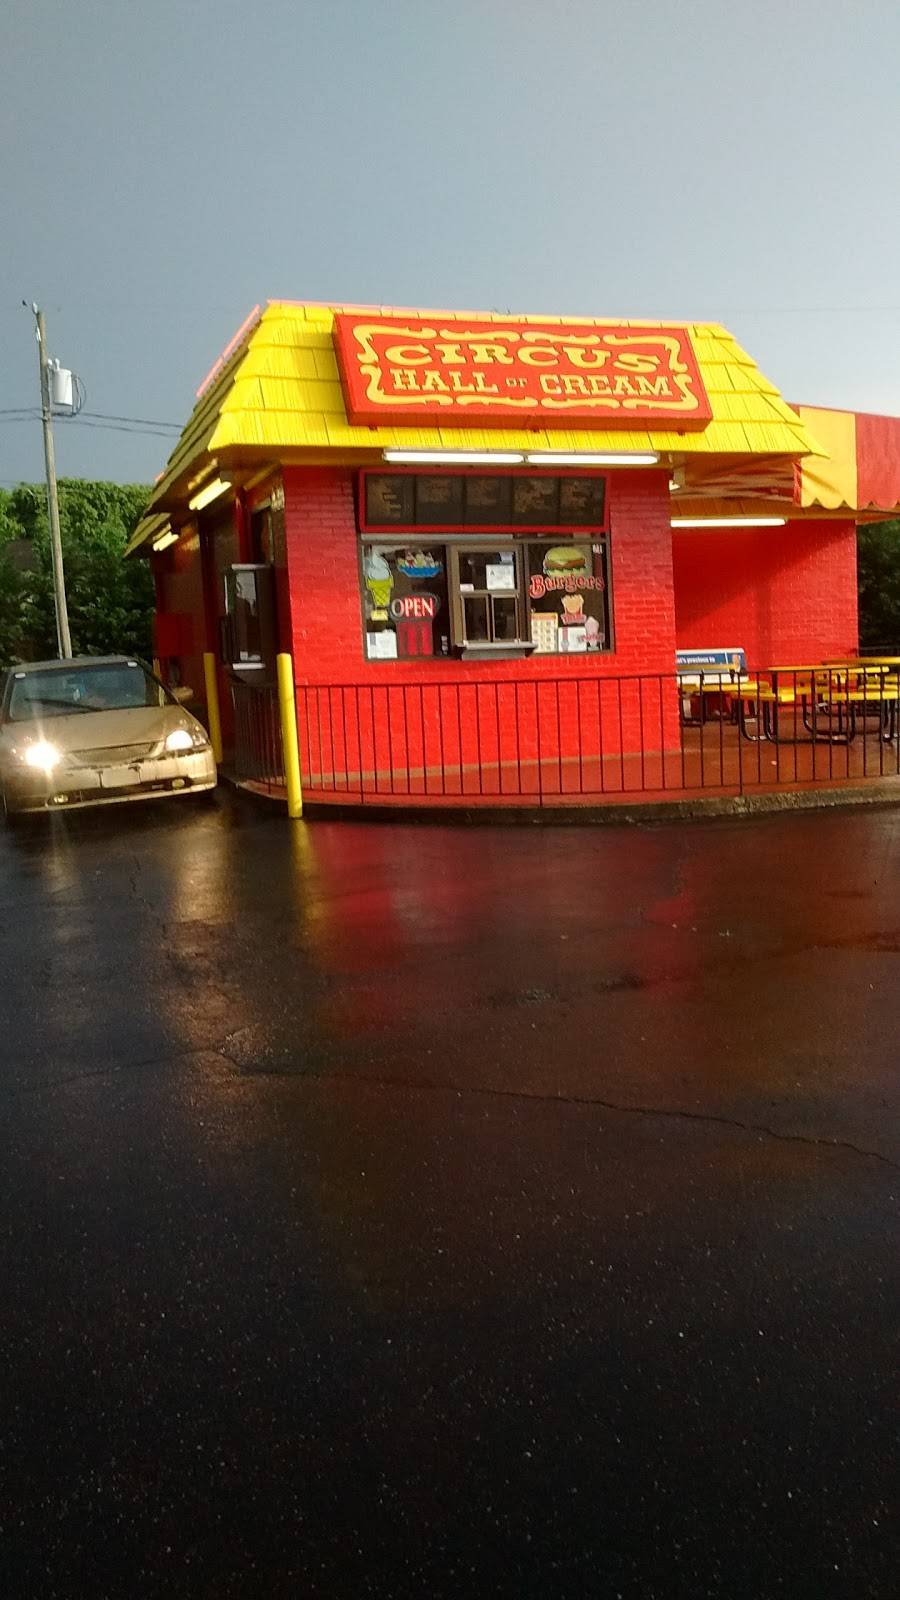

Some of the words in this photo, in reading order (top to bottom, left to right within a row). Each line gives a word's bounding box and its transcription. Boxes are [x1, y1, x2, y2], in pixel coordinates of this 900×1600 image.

[386, 344, 660, 372] CIRCUS
[391, 369, 499, 393] HALL
[540, 374, 671, 396] CREAM
[530, 575, 604, 598] Burgers
[391, 598, 434, 617] OPEN
